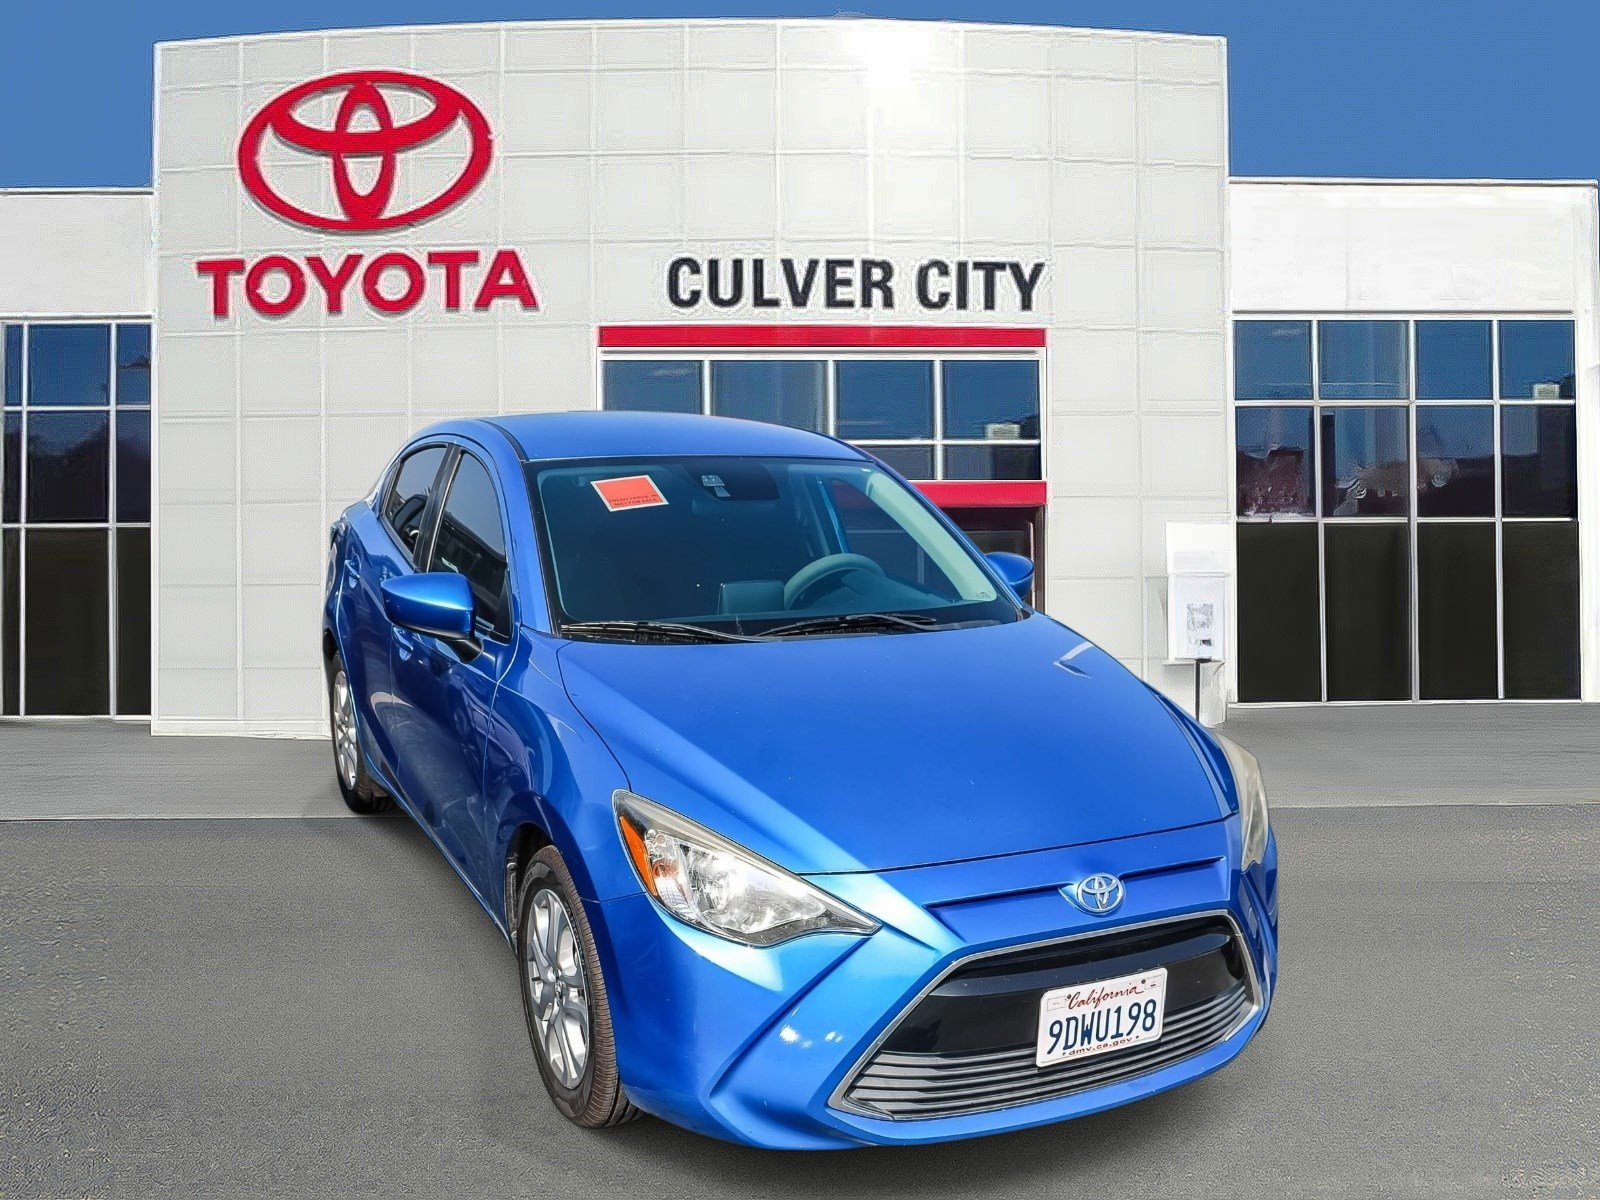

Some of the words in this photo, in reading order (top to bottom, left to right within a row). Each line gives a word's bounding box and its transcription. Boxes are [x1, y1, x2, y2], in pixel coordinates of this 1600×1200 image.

[195, 249, 539, 318] TOYOTA
[667, 257, 895, 309] CULVER
[916, 259, 1045, 311] CITY
[1068, 983, 1144, 1010] California
[1047, 999, 1157, 1055] 9DWU198
[1068, 1037, 1134, 1056] dmv.ca.gov
